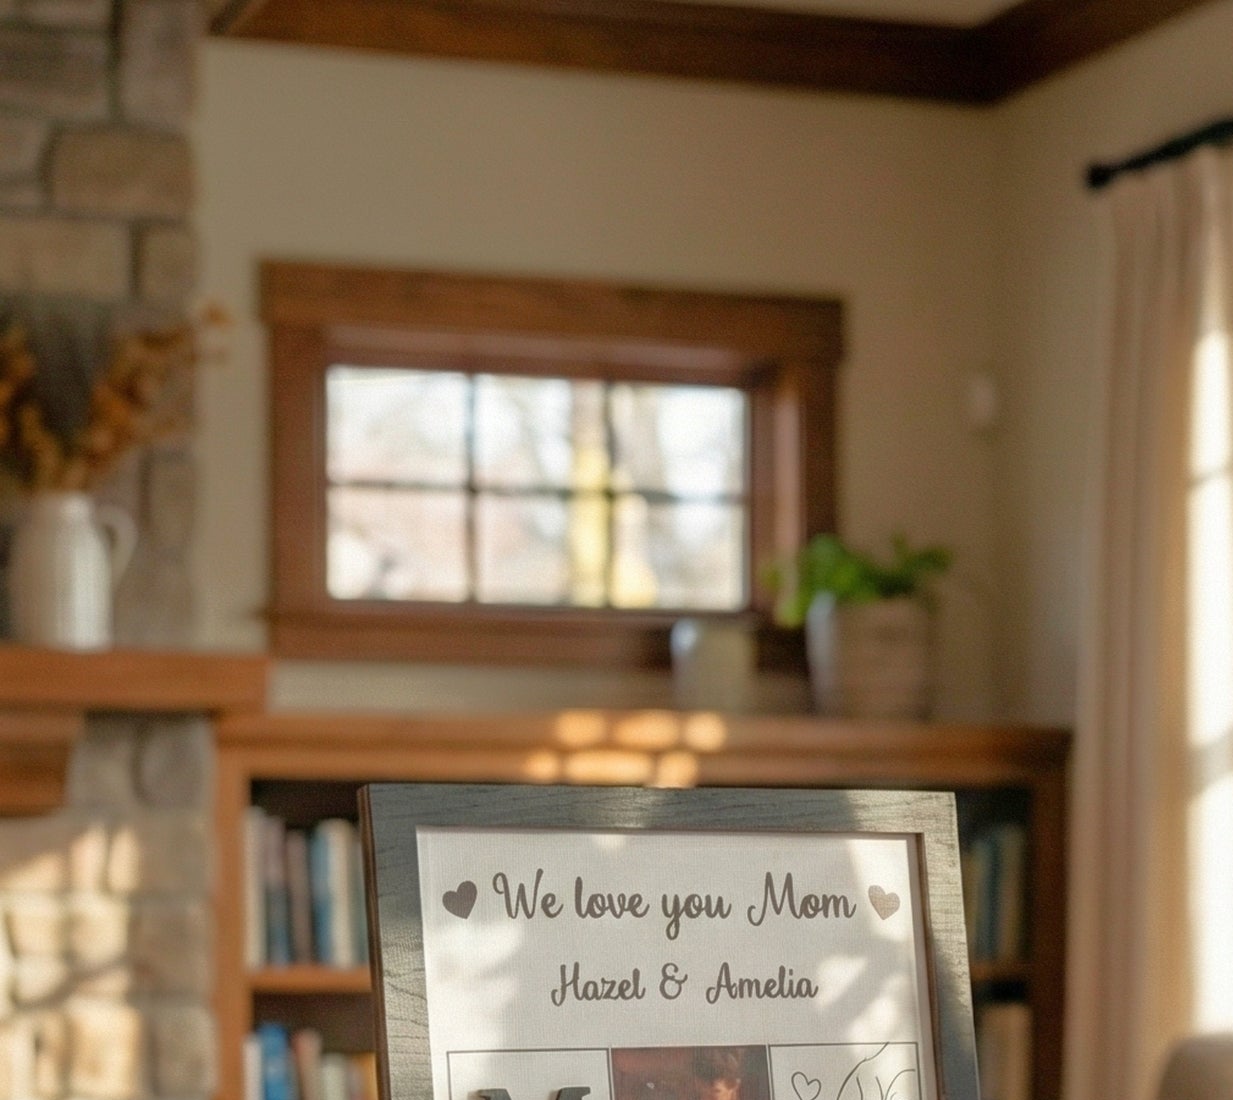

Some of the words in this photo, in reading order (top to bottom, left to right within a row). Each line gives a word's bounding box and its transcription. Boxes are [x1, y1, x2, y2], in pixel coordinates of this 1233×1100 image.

[492, 868, 563, 920] We
[574, 876, 650, 920] love
[661, 893, 732, 941] you
[746, 871, 857, 927] Mom
[550, 961, 646, 1007] Hazel
[658, 962, 688, 1000] &
[705, 961, 819, 1005] Amelia
